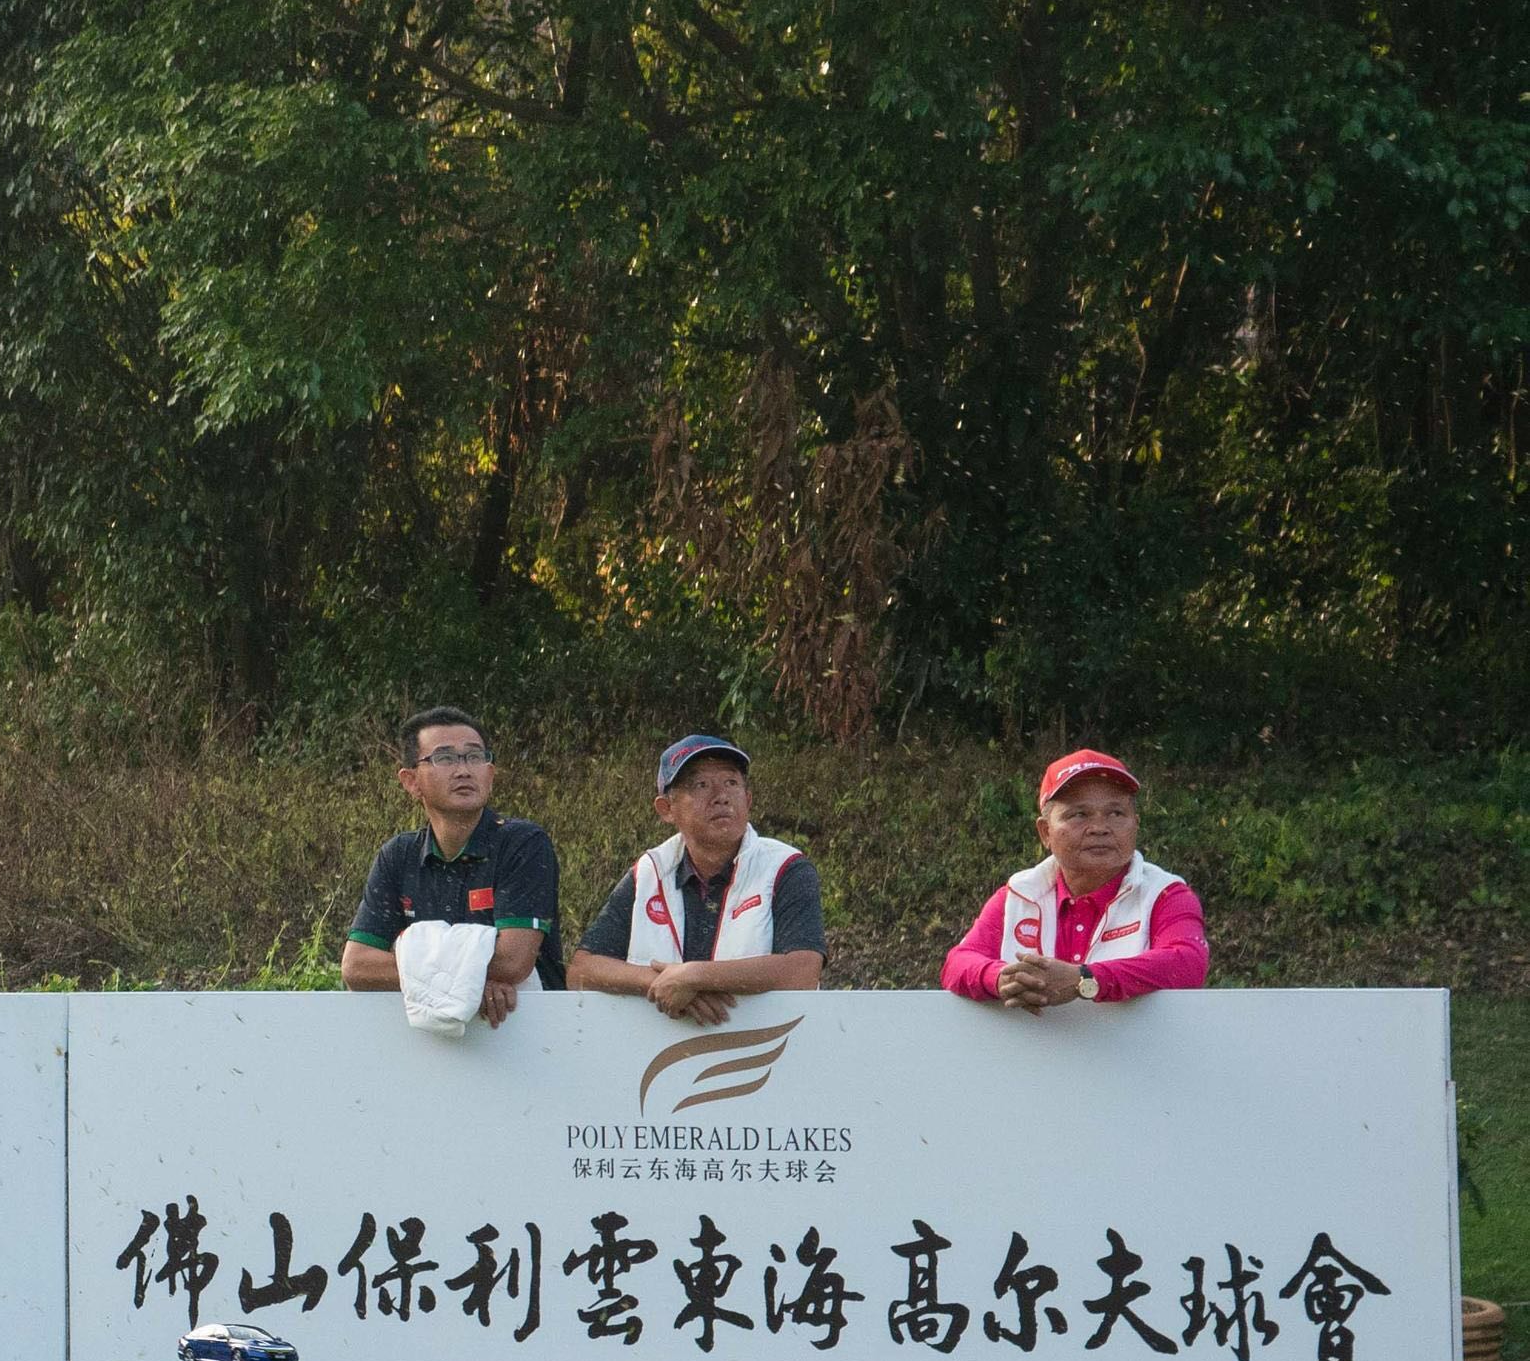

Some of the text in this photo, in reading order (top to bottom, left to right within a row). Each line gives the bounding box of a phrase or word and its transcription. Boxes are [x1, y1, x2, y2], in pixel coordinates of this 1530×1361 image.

[567, 1125, 852, 1153] POLY EMERALD LAKES
[572, 1157, 838, 1184] 保利云东海高尔夫球会
